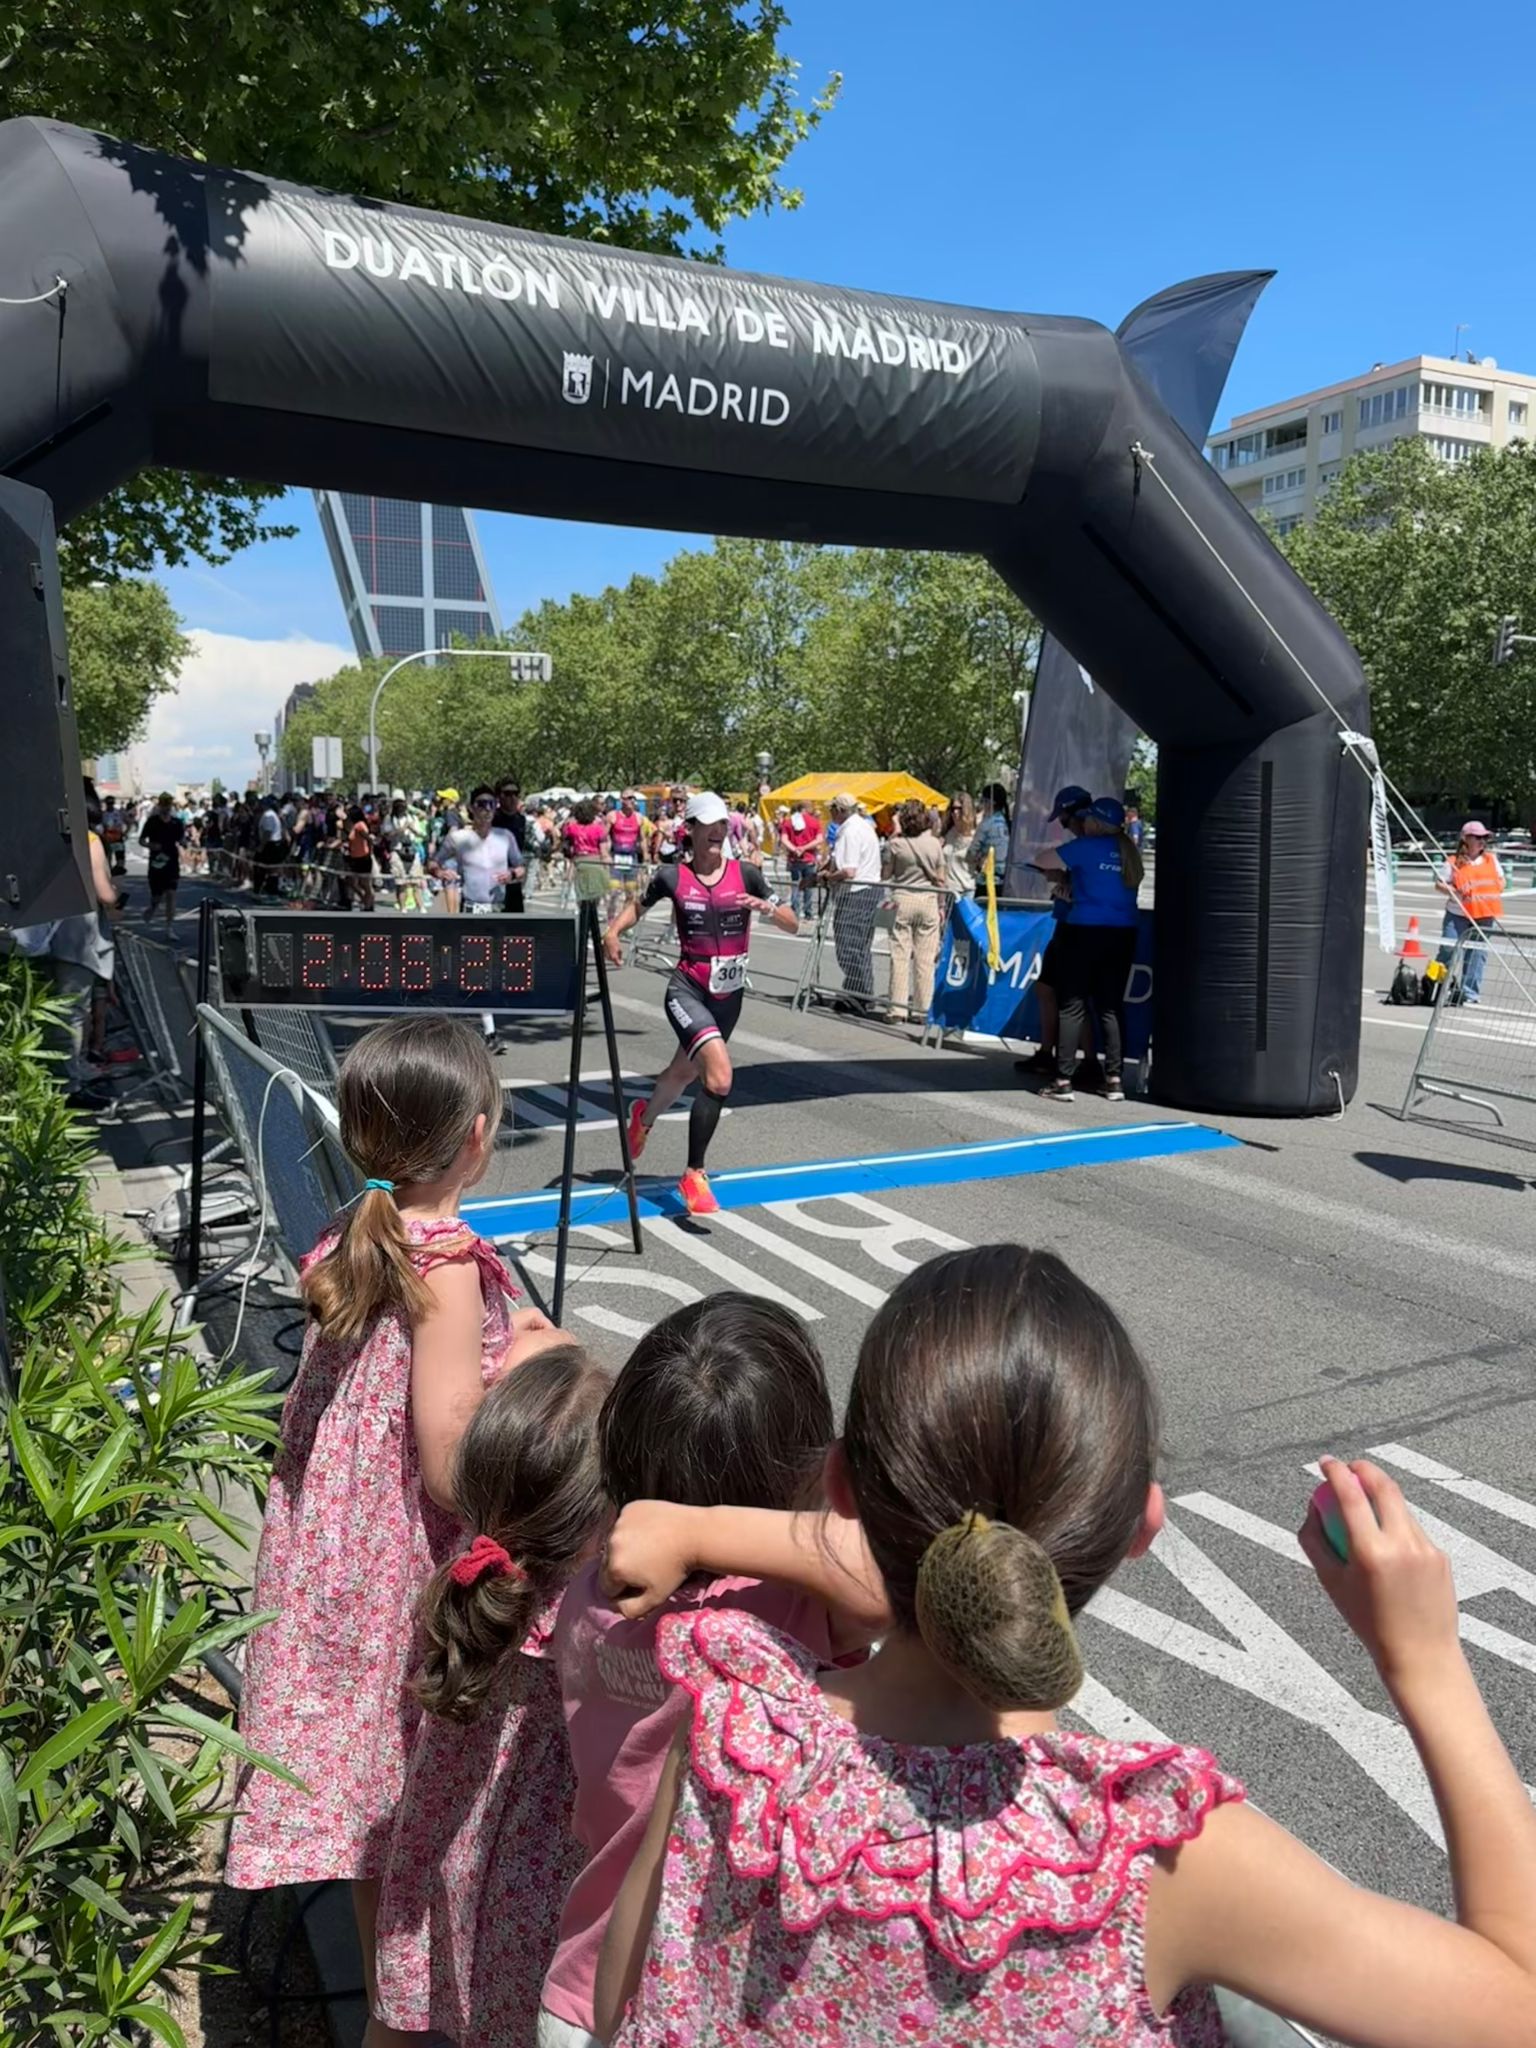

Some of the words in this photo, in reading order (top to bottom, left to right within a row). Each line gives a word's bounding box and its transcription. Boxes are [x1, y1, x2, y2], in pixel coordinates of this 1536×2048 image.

[323, 228, 560, 310] DUATLÓN
[585, 281, 711, 337] VILLA
[735, 305, 789, 349] DE
[812, 319, 968, 375] MADRID
[621, 366, 790, 427] MADRID
[302, 934, 533, 991] 2:06:29
